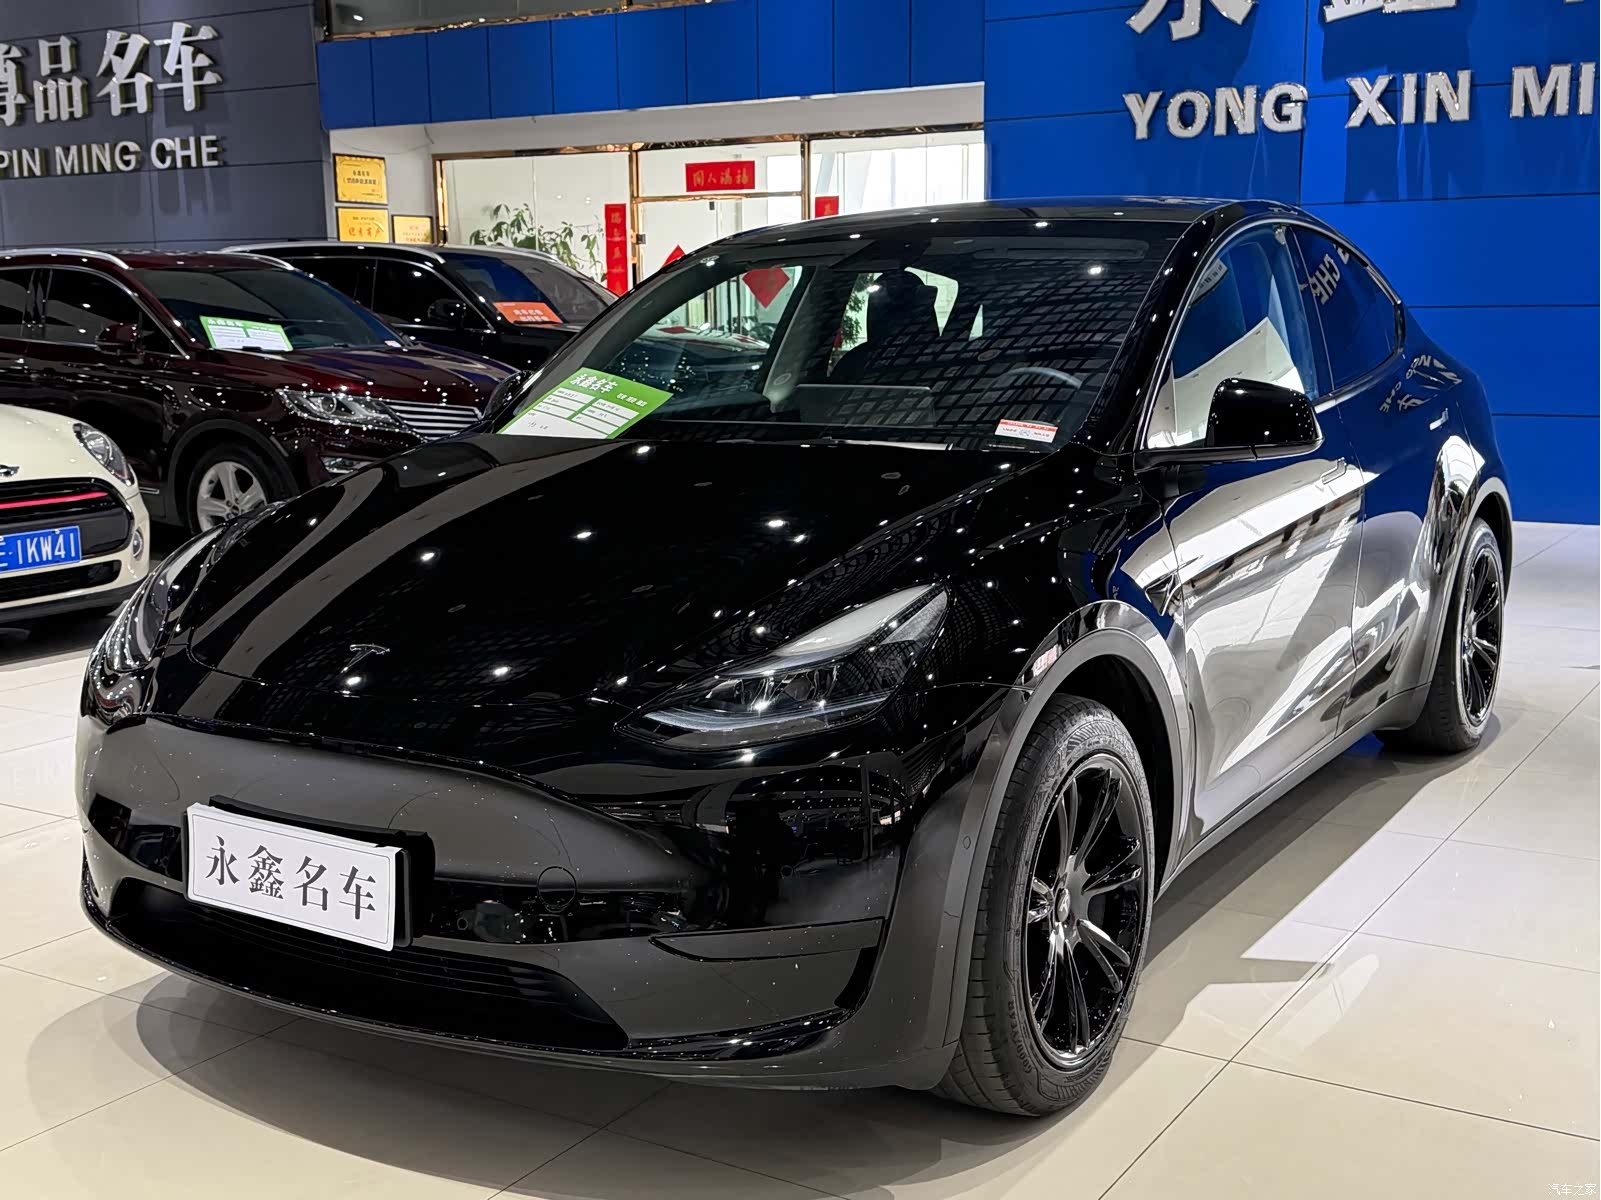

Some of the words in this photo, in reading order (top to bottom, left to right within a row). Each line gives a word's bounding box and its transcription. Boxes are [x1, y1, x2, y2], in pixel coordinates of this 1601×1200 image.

[1122, 81, 1308, 140] YONG
[1344, 69, 1472, 128] XIN
[1510, 61, 1597, 118] MI
[55, 140, 141, 176] MING
[151, 135, 220, 170] CHE
[205, 834, 377, 921] 永鑫名车
